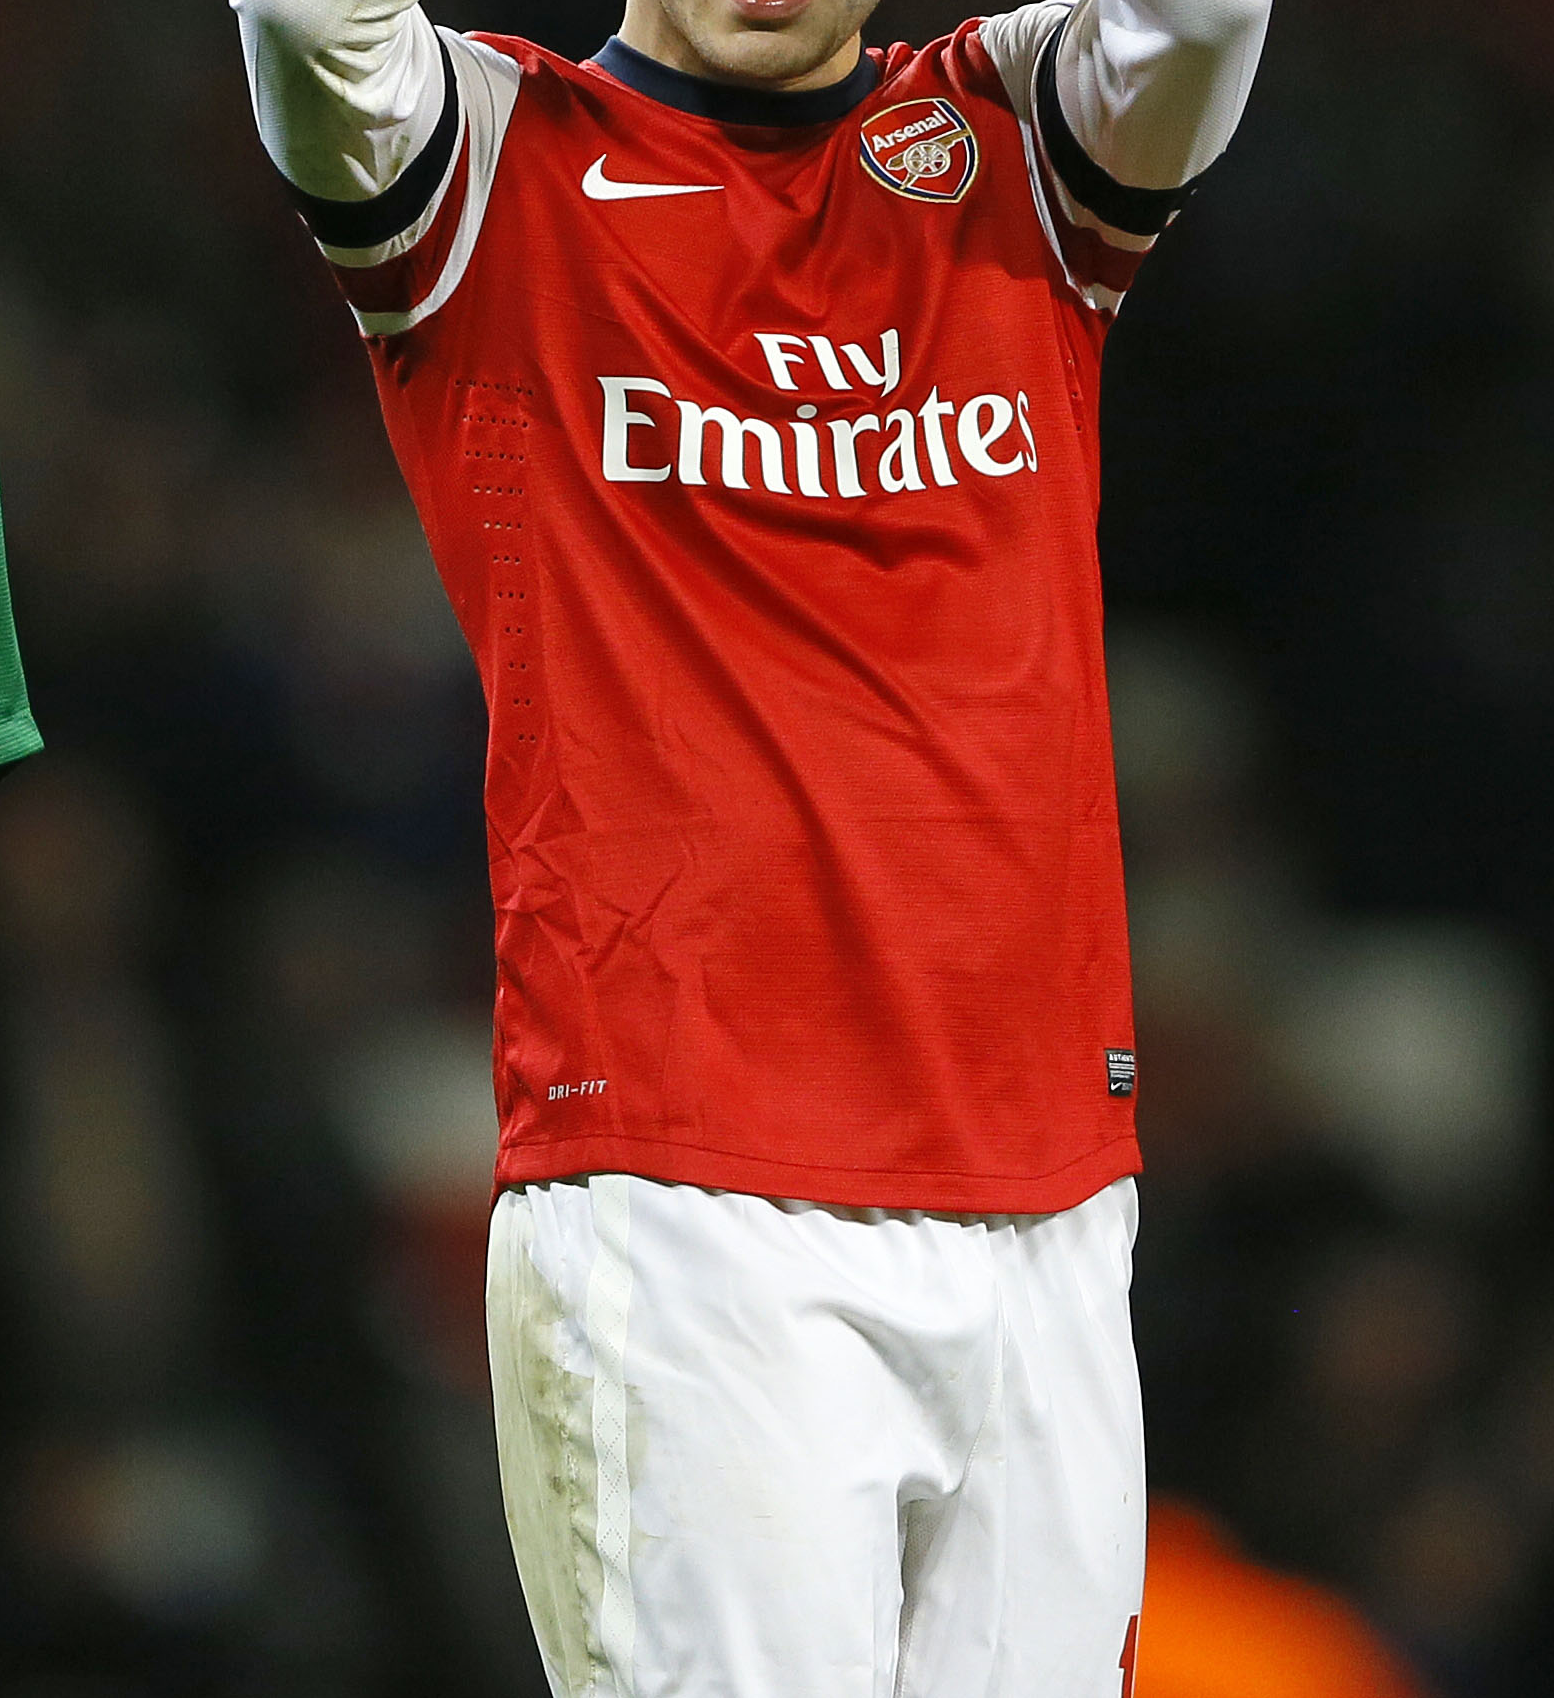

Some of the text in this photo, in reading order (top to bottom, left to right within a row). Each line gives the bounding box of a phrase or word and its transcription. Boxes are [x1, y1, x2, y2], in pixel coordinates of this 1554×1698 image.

[871, 110, 948, 153] Arsenal
[753, 328, 902, 398] Fly
[596, 375, 1038, 499] Emirates
[547, 1079, 608, 1101] DRI-FIT
